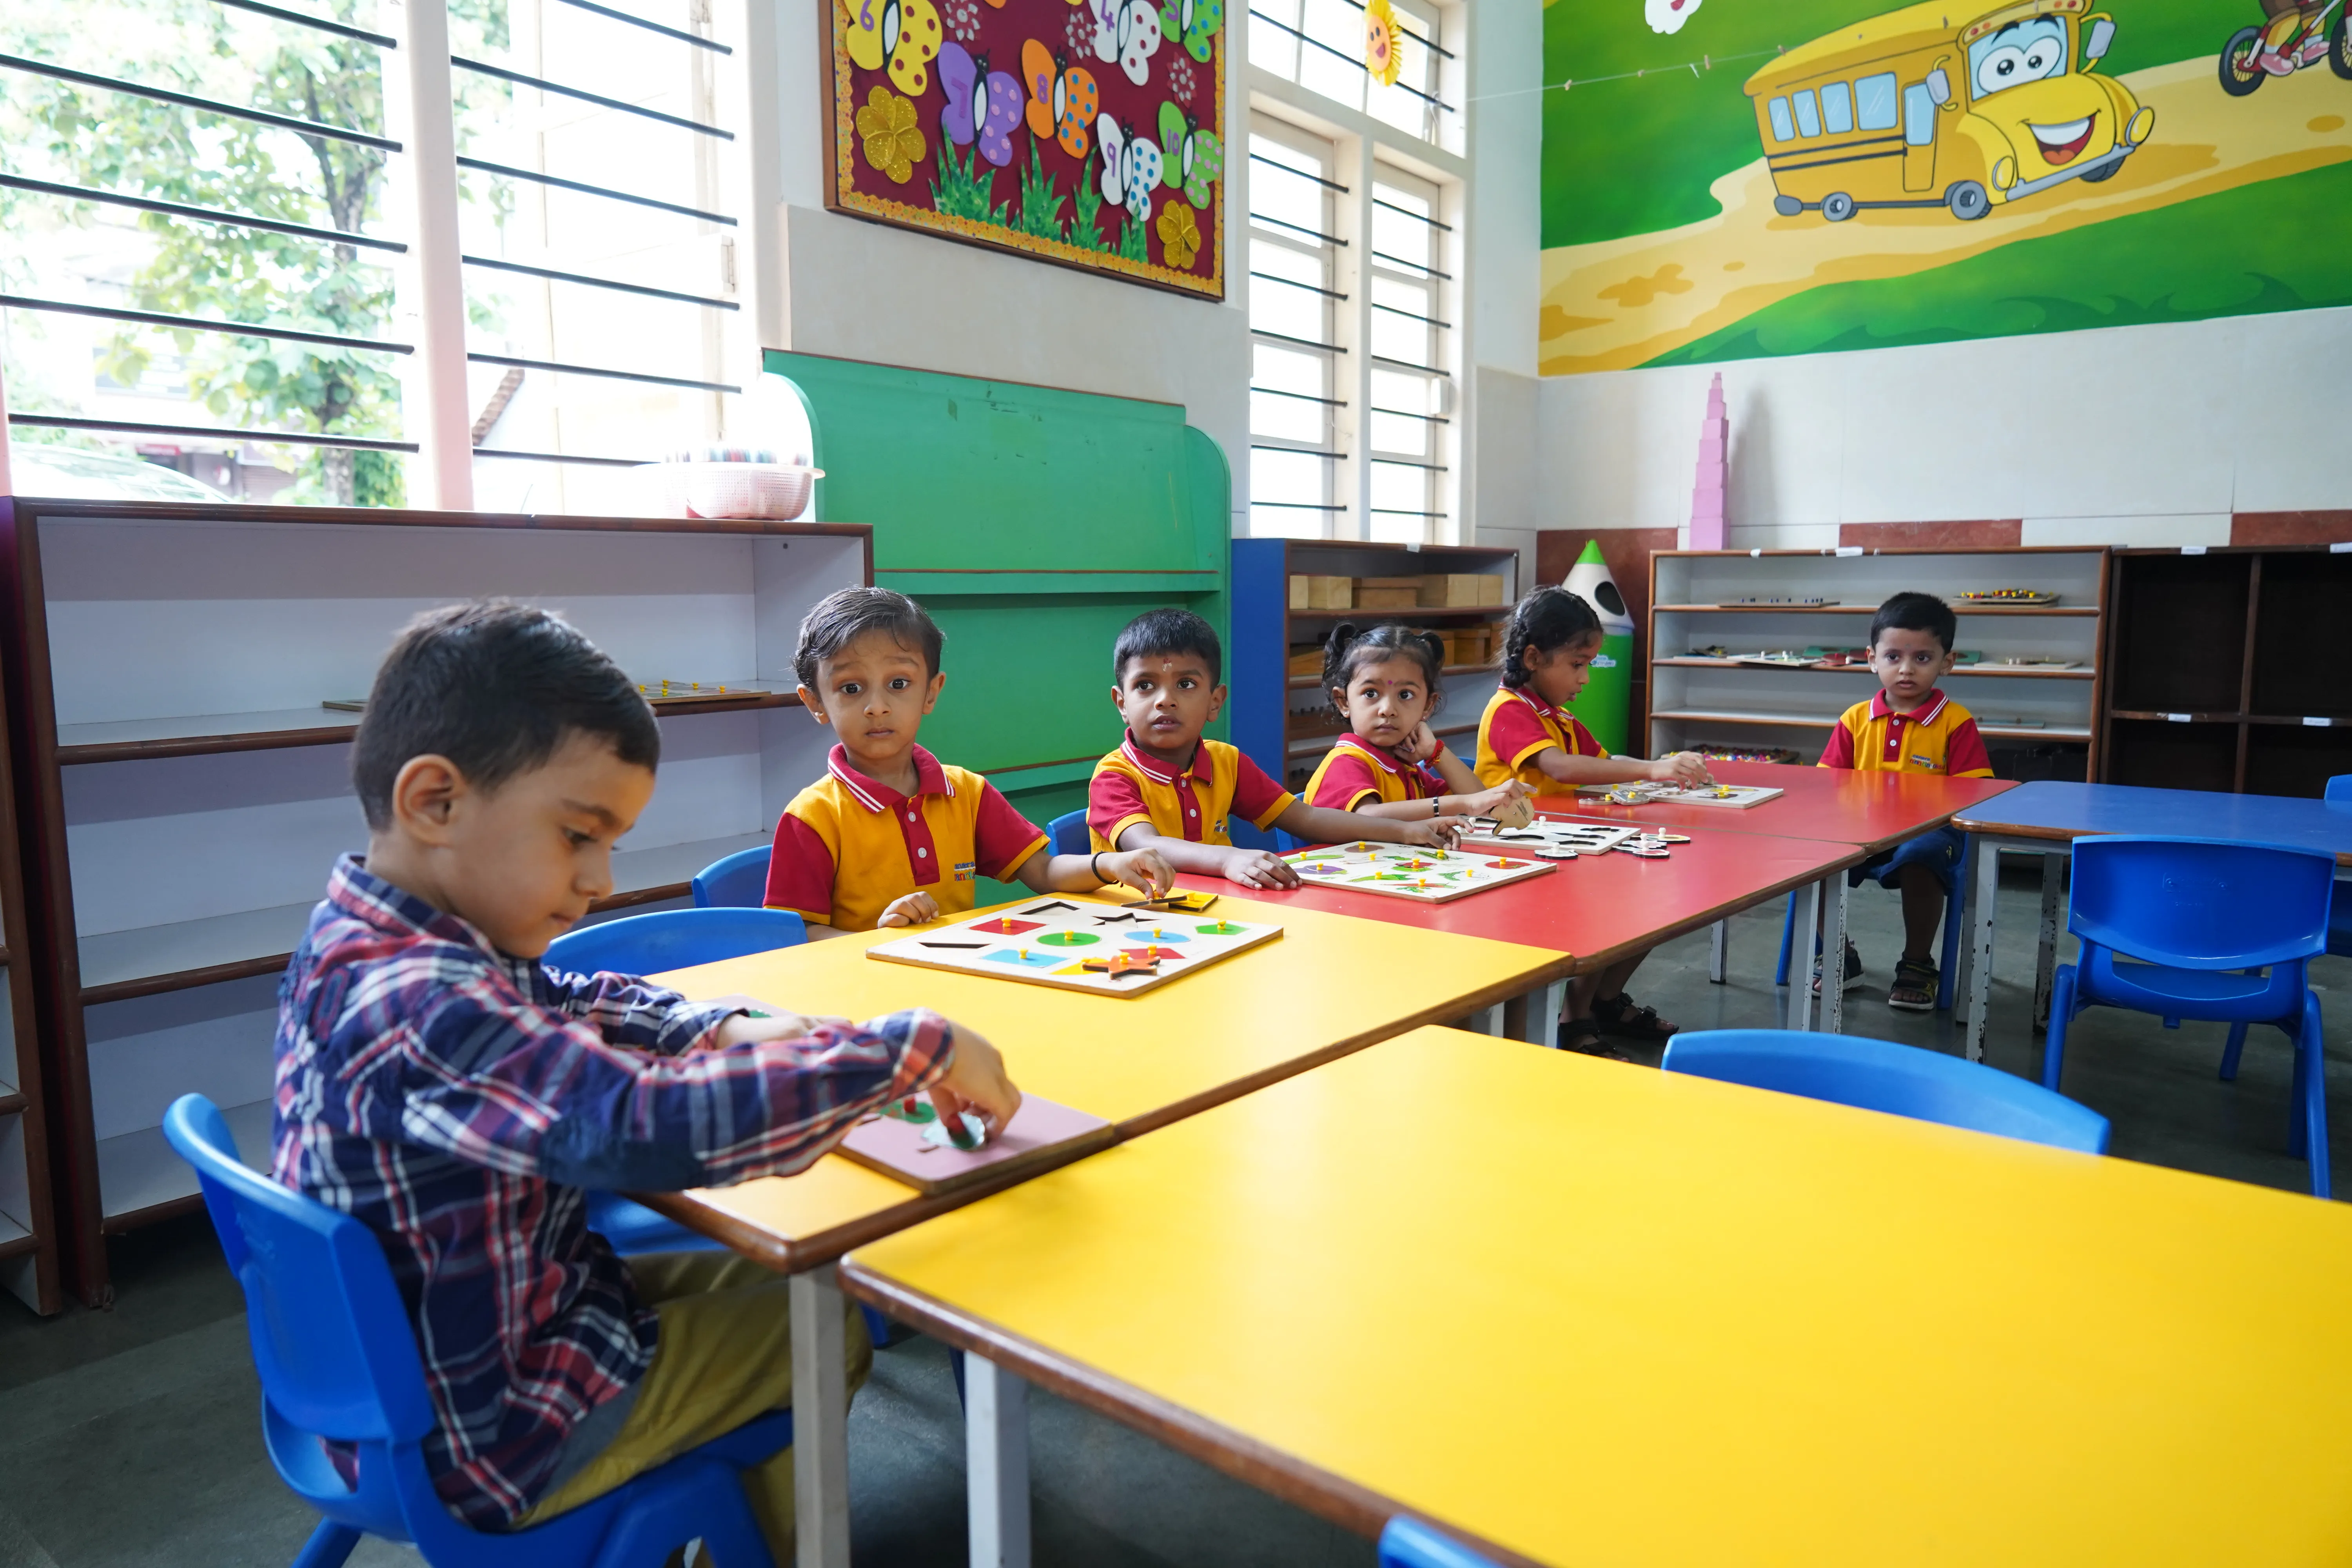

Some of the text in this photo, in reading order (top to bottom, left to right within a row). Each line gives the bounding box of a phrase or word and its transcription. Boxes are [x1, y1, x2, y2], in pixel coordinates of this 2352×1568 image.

[860, 0, 874, 31] 6
[1101, 0, 1115, 33] 4
[951, 77, 968, 118] 7
[1037, 74, 1049, 104] 8
[1167, 128, 1180, 156] 10
[1107, 142, 1116, 178] 9
